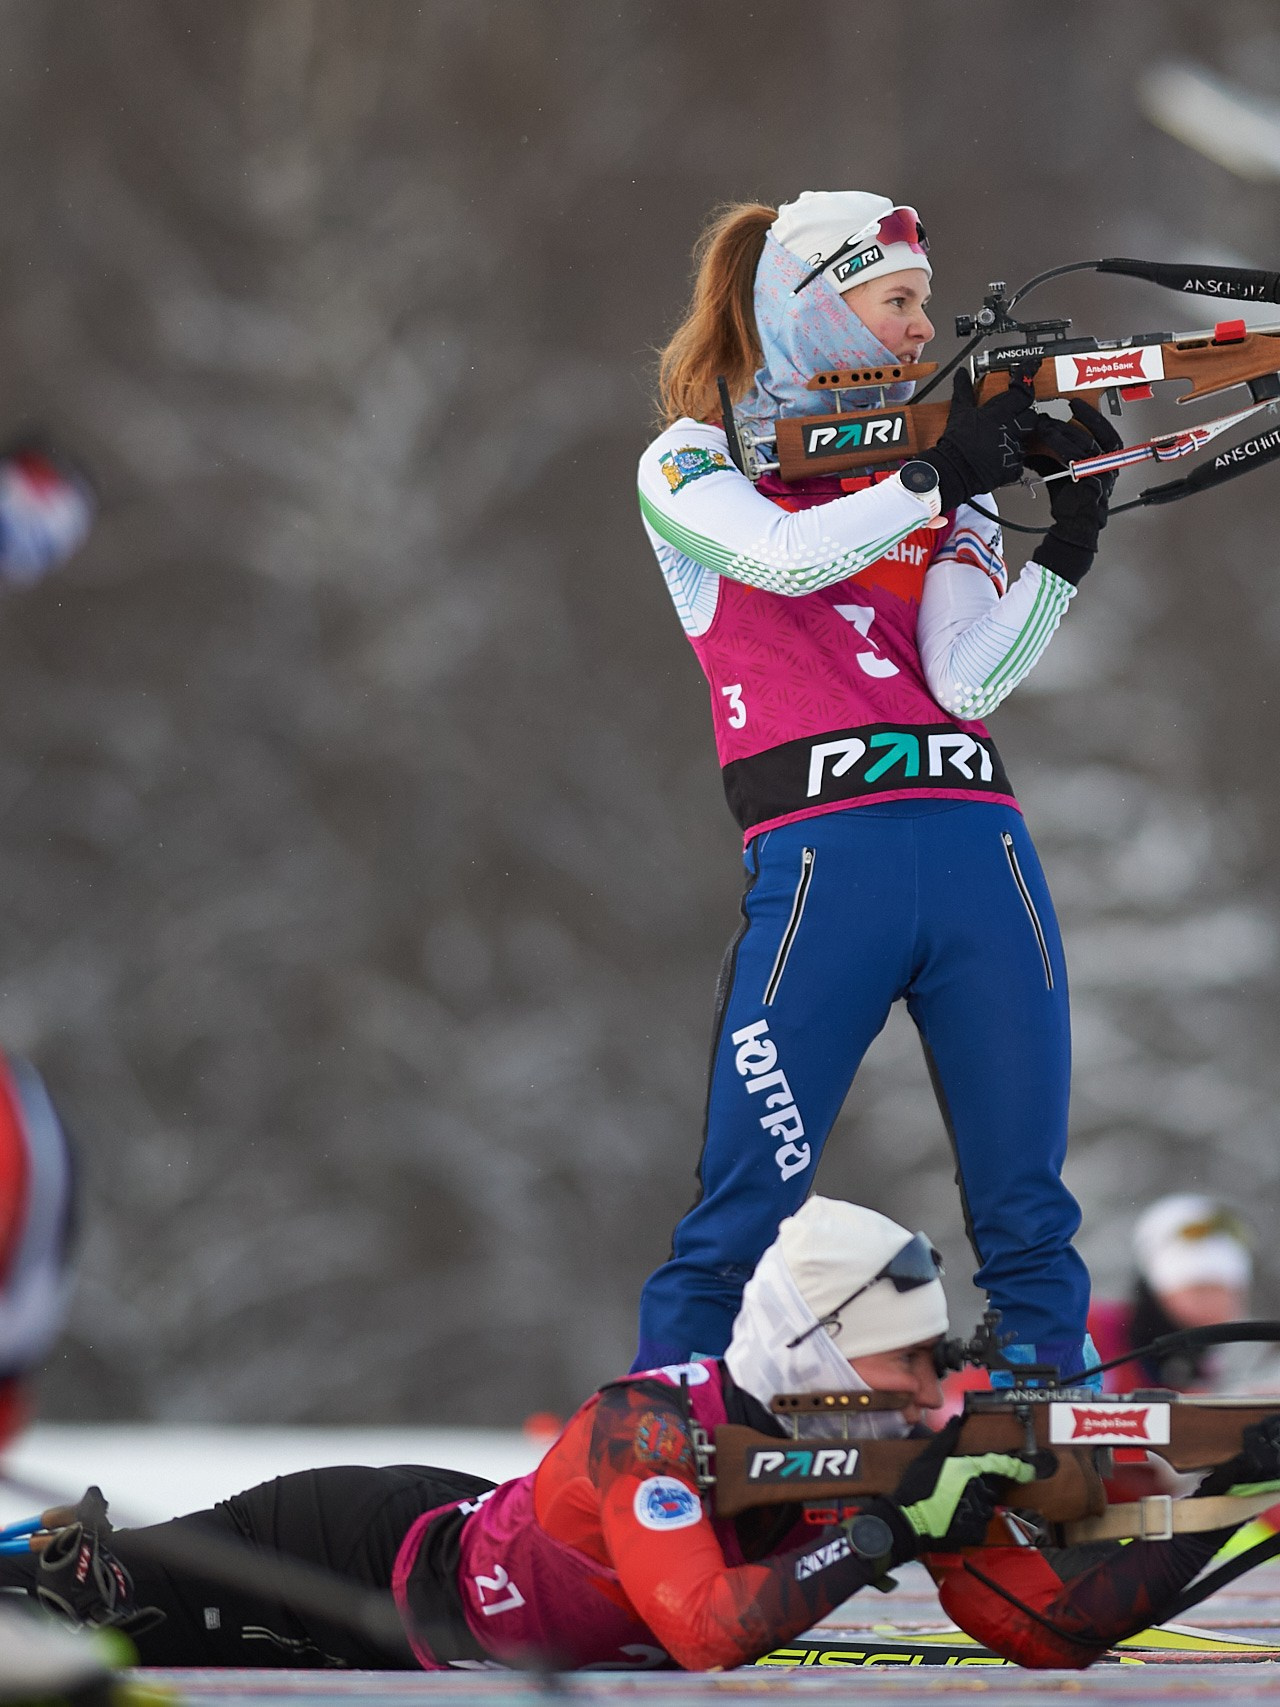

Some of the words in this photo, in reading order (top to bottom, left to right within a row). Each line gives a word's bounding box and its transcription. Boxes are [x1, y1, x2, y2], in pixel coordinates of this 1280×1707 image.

[838, 247, 880, 280] PARI
[1085, 363, 1113, 377] Альфа
[1112, 362, 1134, 371] Банк
[808, 417, 903, 454] PARI
[832, 604, 901, 679] 3
[721, 683, 747, 730] 3
[806, 731, 994, 798] PARI
[748, 1448, 859, 1478] PARI
[474, 1563, 526, 1616] 27
